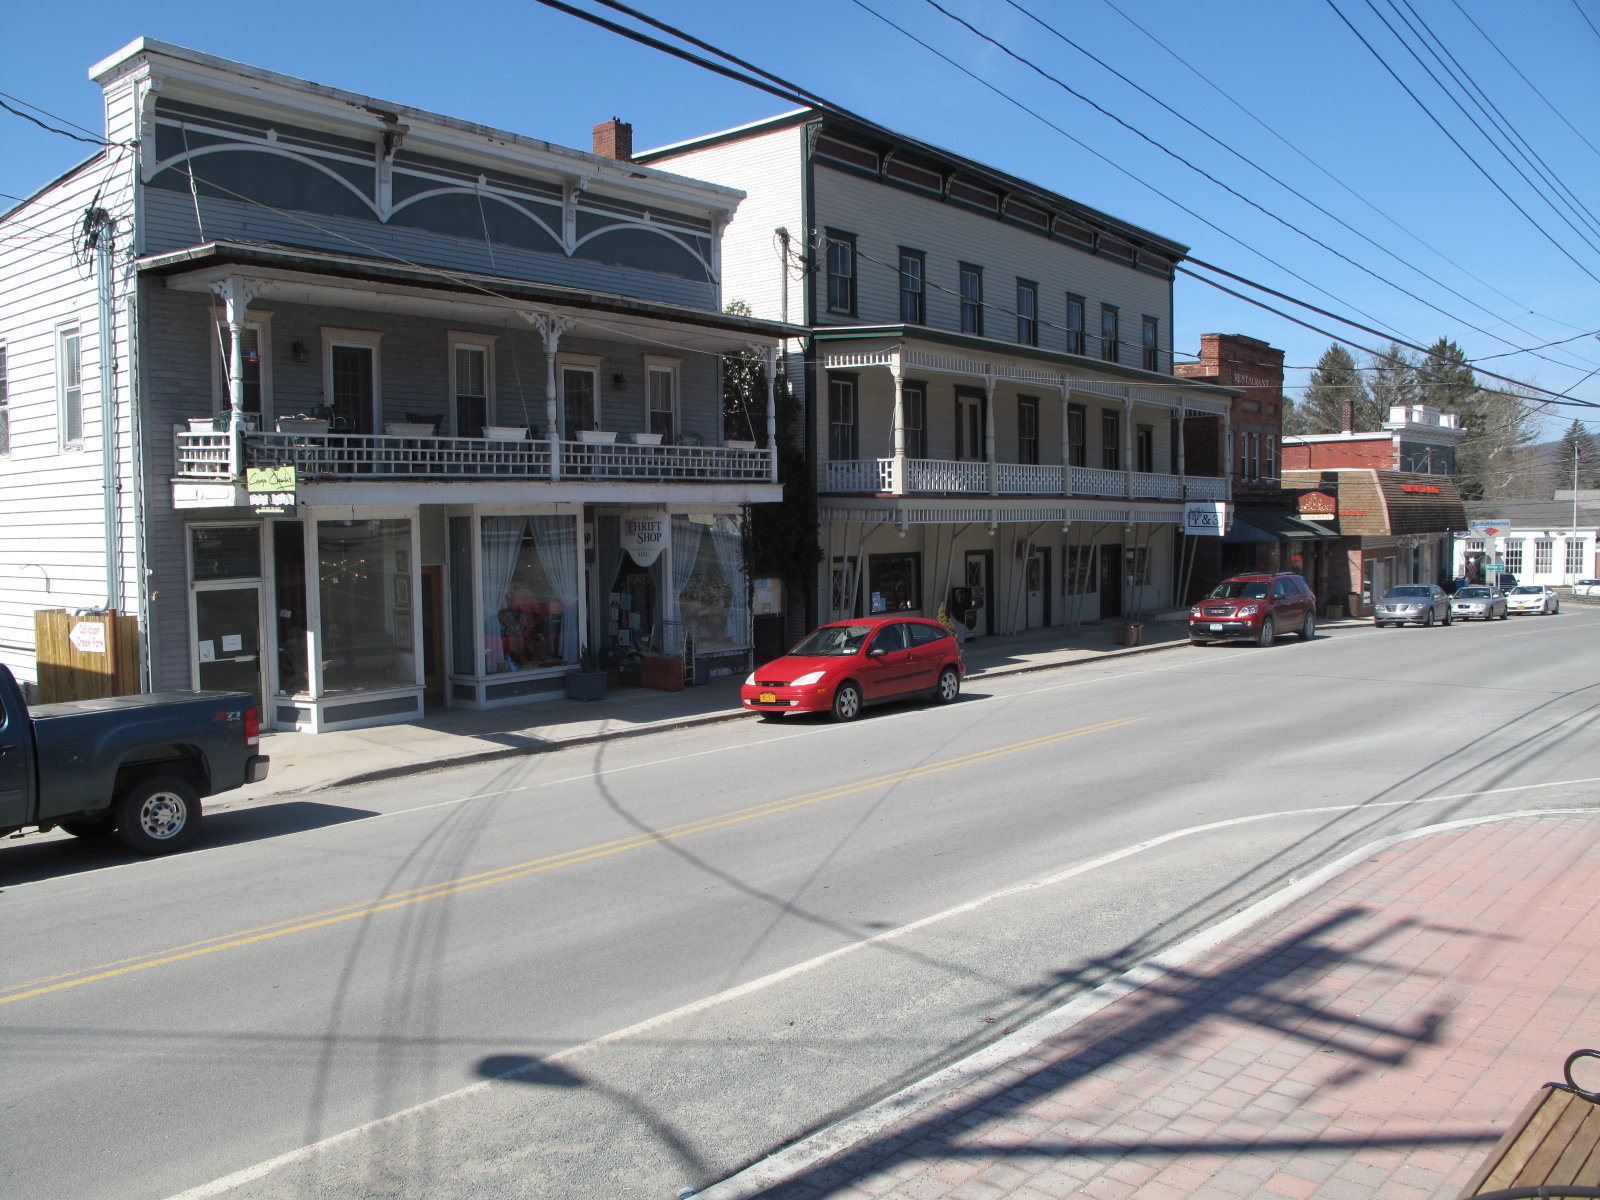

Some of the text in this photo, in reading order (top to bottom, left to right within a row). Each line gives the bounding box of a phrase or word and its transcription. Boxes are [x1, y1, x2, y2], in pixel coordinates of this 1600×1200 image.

[1234, 372, 1269, 387] RESTAURANT
[1202, 514, 1211, 525] &
[626, 521, 663, 534] THRIFT
[637, 532, 662, 544] SHOP
[79, 624, 101, 635] Callicoon
[76, 637, 104, 648] Creek Park
